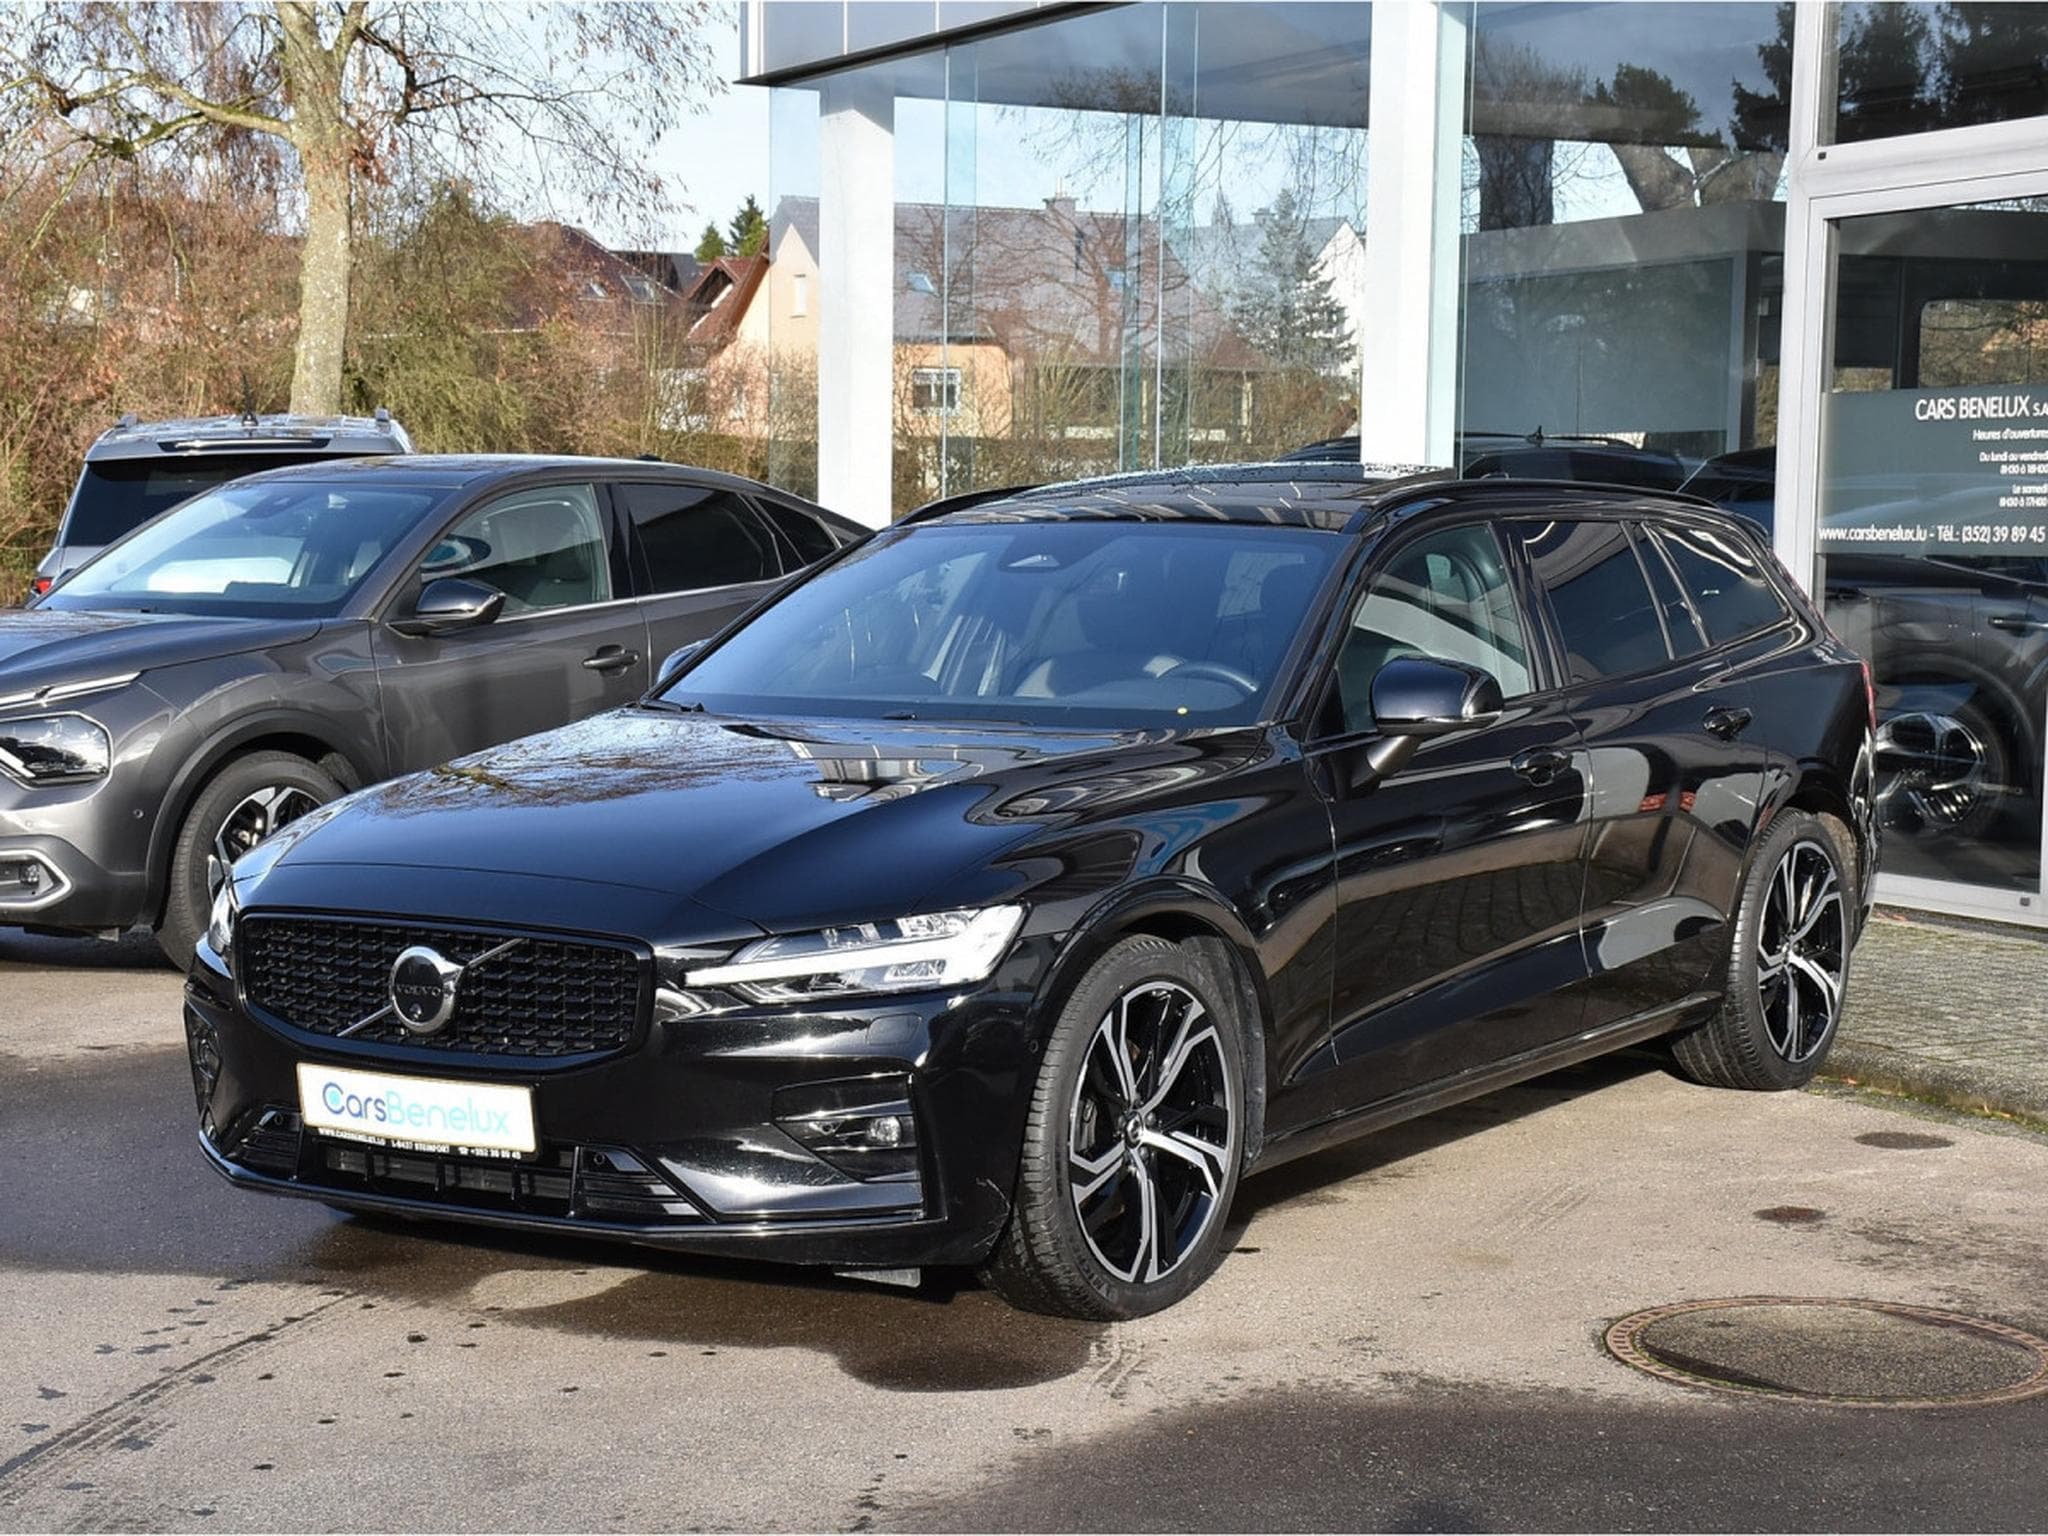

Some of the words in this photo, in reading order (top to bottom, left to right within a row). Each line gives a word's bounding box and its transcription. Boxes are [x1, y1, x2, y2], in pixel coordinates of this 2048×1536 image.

[1915, 398, 1956, 420] CARS
[1959, 395, 2030, 418] BENELUX
[1818, 524, 1927, 541] www.carsbenelux.lu
[1961, 525, 1991, 544] (352)
[1992, 526, 2008, 542] 39
[2010, 526, 2026, 543] 89
[2028, 525, 2047, 543] 45
